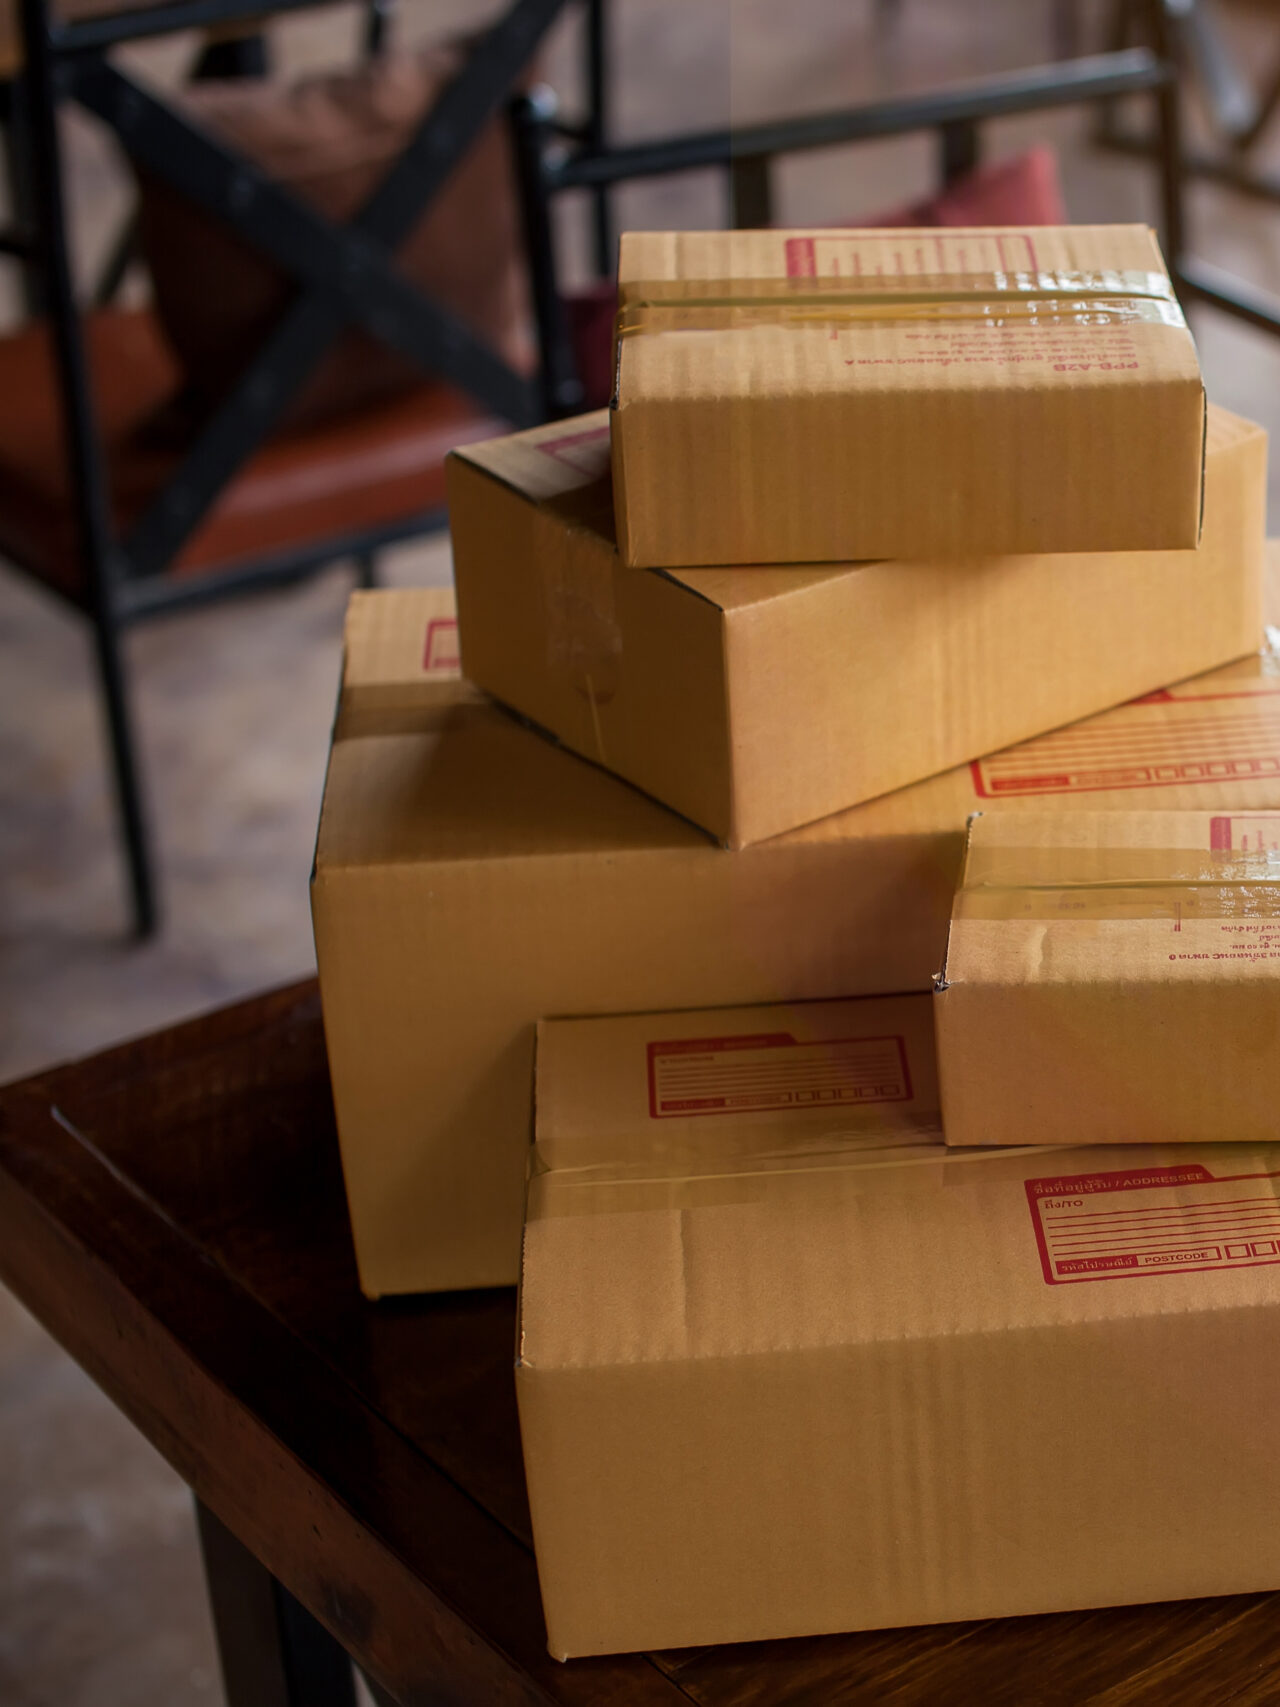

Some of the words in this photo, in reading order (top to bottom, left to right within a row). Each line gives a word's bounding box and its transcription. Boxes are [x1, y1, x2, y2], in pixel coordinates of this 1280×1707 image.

[1053, 361, 1138, 371] PPB-A2B
[1123, 1172, 1204, 1187] ADDRESSEE
[1144, 1251, 1209, 1264] POSTCODE
